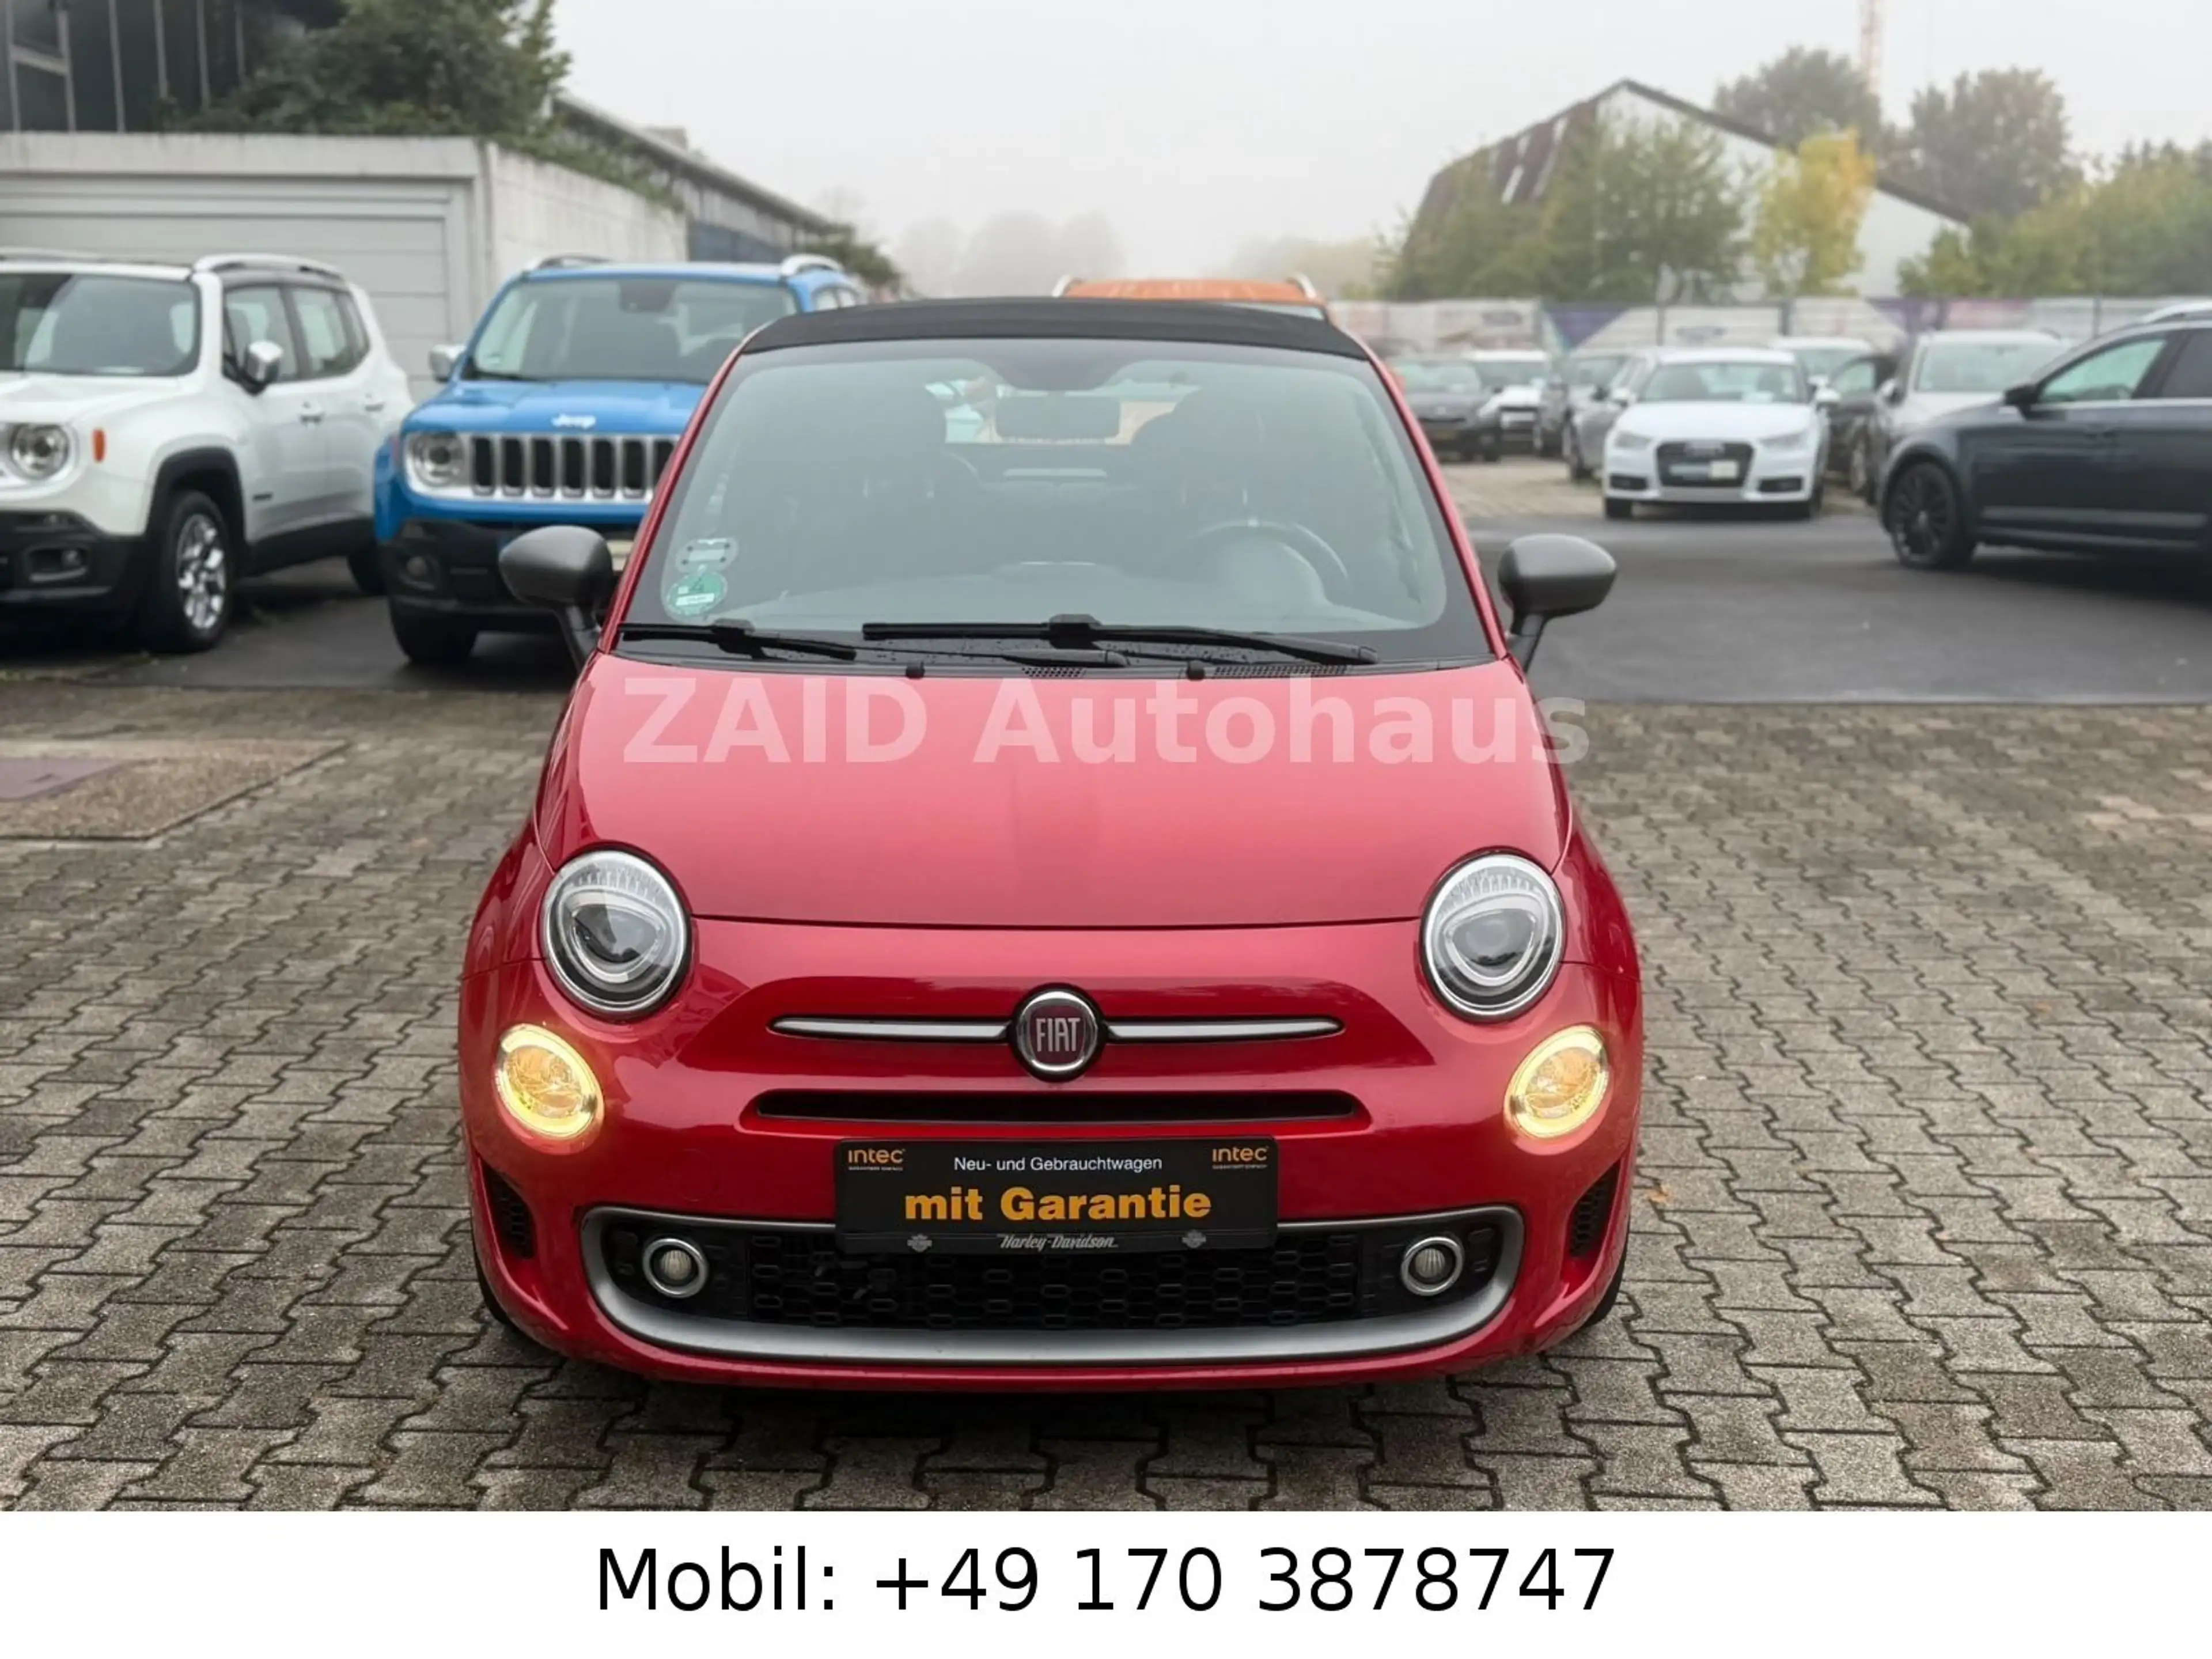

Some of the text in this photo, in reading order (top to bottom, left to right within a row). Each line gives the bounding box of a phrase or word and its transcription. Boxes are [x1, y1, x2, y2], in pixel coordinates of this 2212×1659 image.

[1035, 1017, 1081, 1052] FIAT
[848, 1148, 904, 1164] intec
[1211, 1146, 1267, 1162] intec
[954, 1156, 1162, 1173] Neu- und Gebrauchtwagen
[905, 1184, 1212, 1221] mit Garantie
[996, 1233, 1118, 1252] Harley-Davidson
